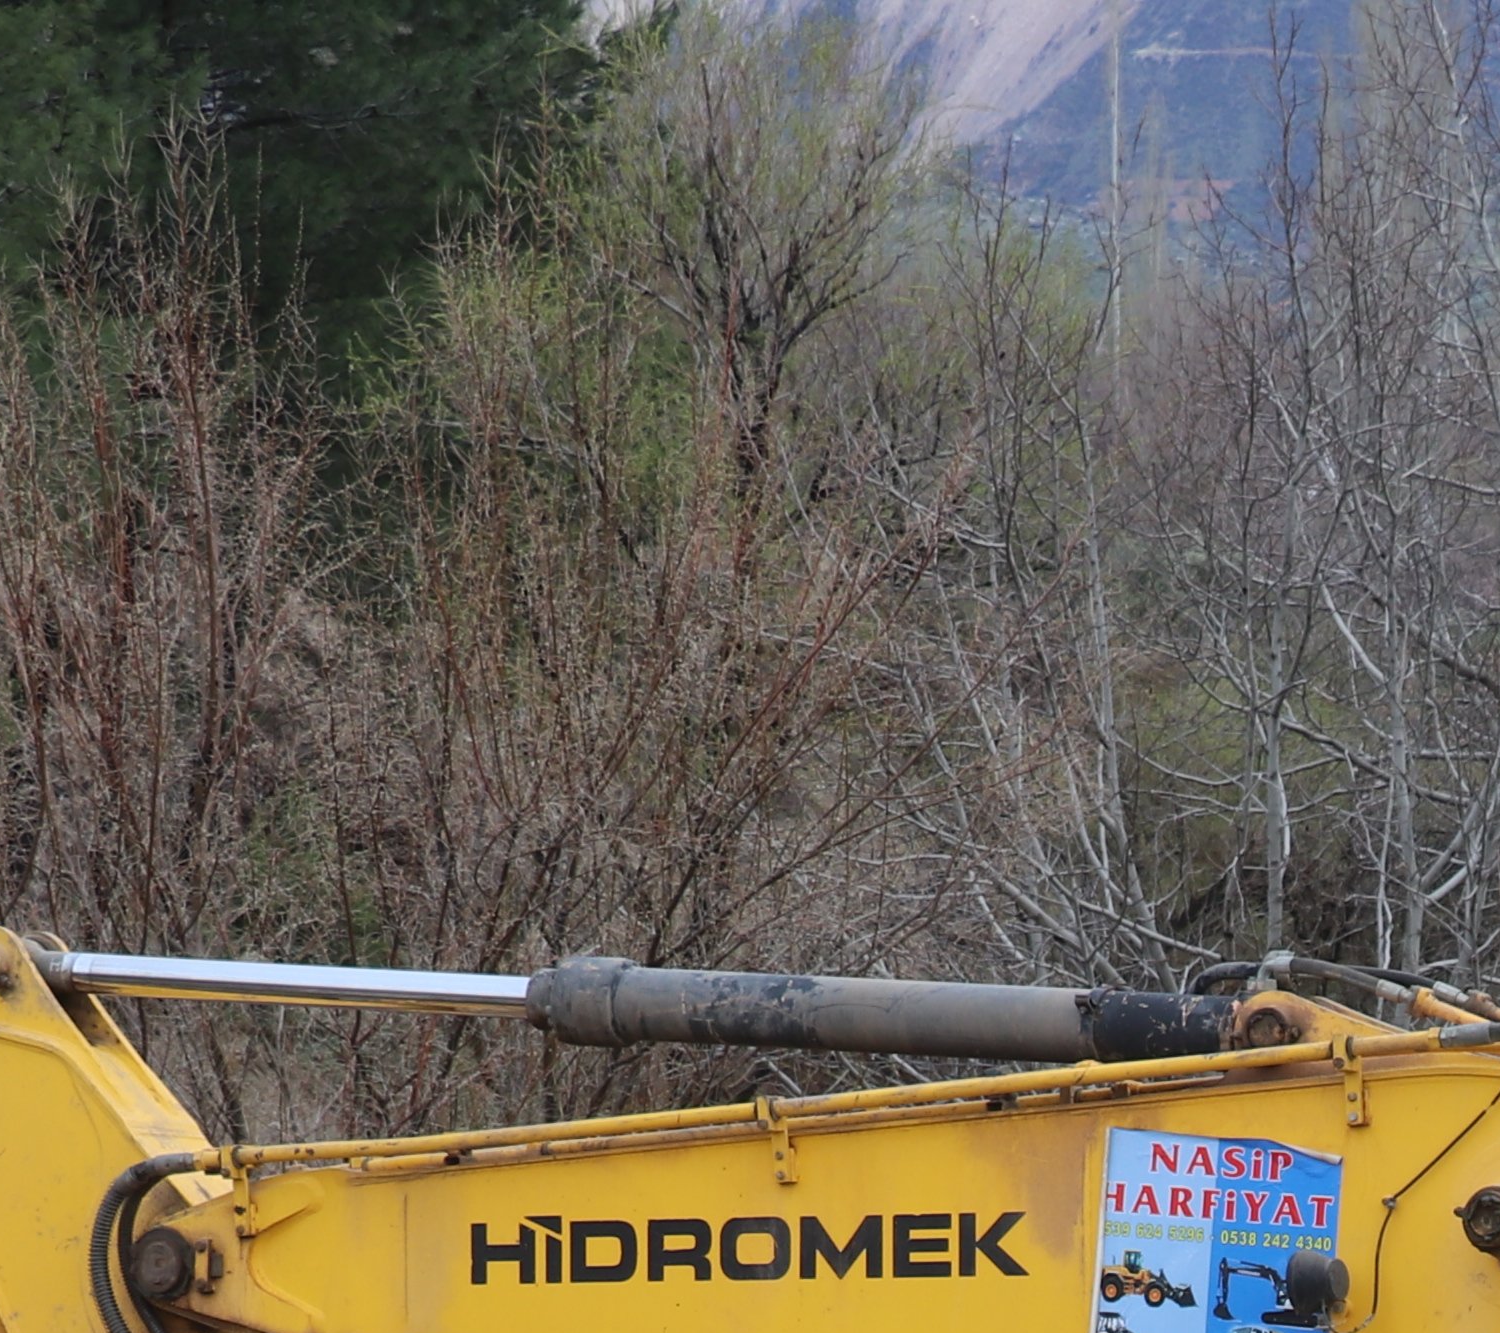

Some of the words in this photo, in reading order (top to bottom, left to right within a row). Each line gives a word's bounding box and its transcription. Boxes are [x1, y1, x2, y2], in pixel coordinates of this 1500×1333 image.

[1136, 1223, 1162, 1240] 624
[1168, 1226, 1204, 1243] 5296
[1221, 1230, 1257, 1246] 0538
[1263, 1233, 1290, 1249] 242
[1295, 1235, 1332, 1252] 4340
